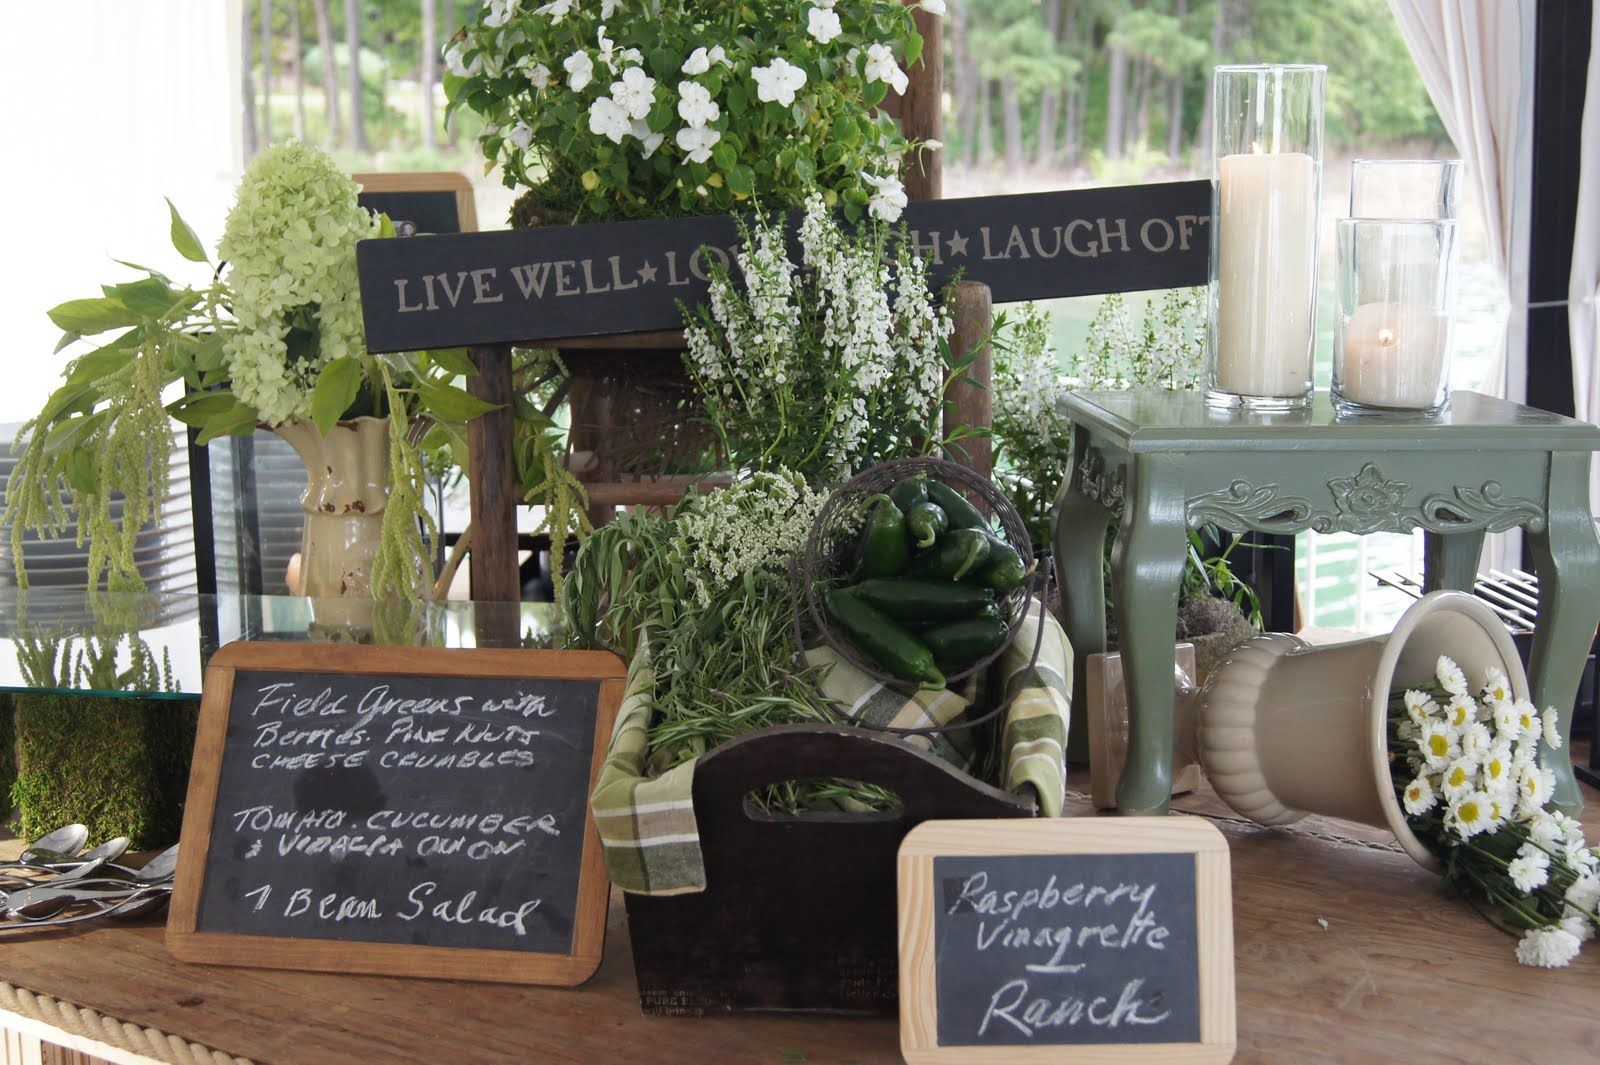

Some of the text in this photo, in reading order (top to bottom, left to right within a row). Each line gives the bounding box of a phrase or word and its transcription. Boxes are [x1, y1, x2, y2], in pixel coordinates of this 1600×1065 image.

[394, 268, 503, 313] LIVE
[510, 255, 639, 300] WELL
[980, 217, 1131, 260] LAUGH
[251, 682, 559, 730] Field Greens with
[251, 750, 370, 769] CHEESE
[366, 810, 560, 836] CUCUMBER
[283, 889, 382, 920] Bean
[396, 881, 541, 936] Salad
[948, 871, 1158, 920] Raspberry
[977, 978, 1173, 1037] Ranch
